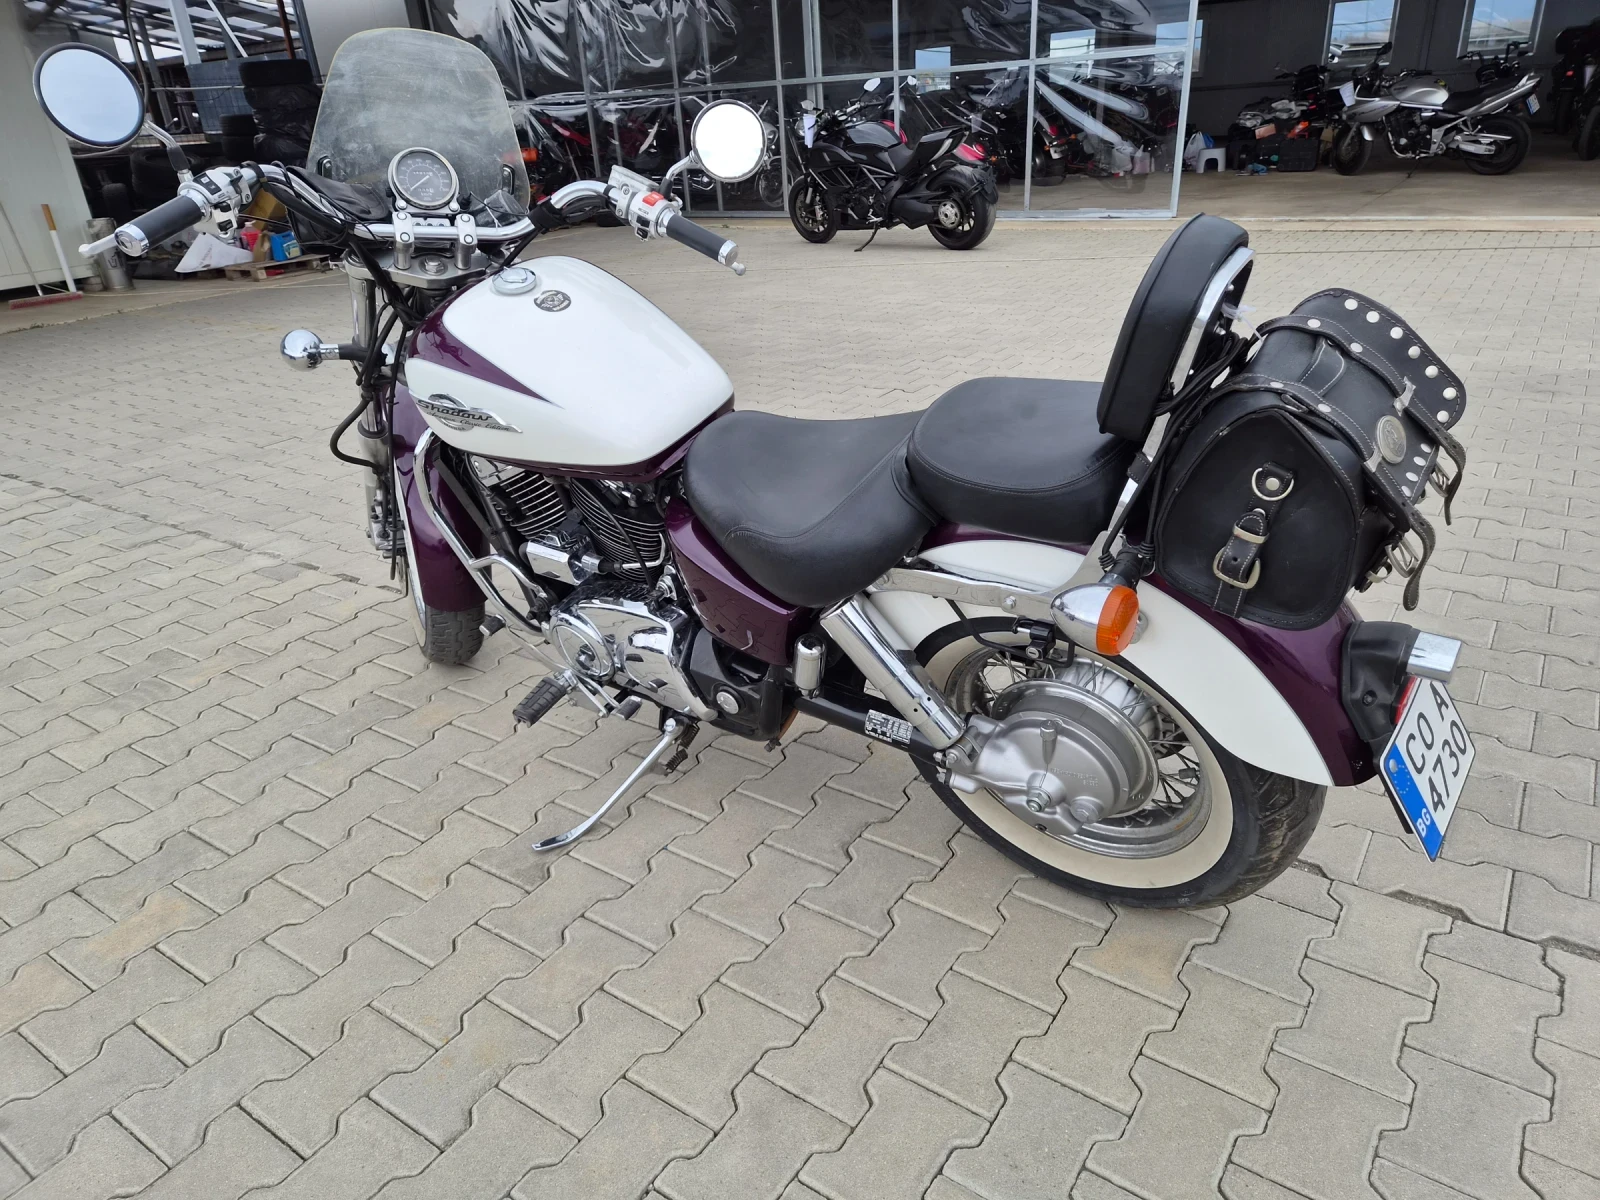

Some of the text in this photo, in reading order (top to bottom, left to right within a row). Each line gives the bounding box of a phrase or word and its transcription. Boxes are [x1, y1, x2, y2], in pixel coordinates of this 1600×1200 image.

[416, 399, 492, 421] Shadow
[1405, 681, 1449, 775] CO A
[1428, 719, 1467, 813] 4730
[1415, 808, 1431, 838] BG
